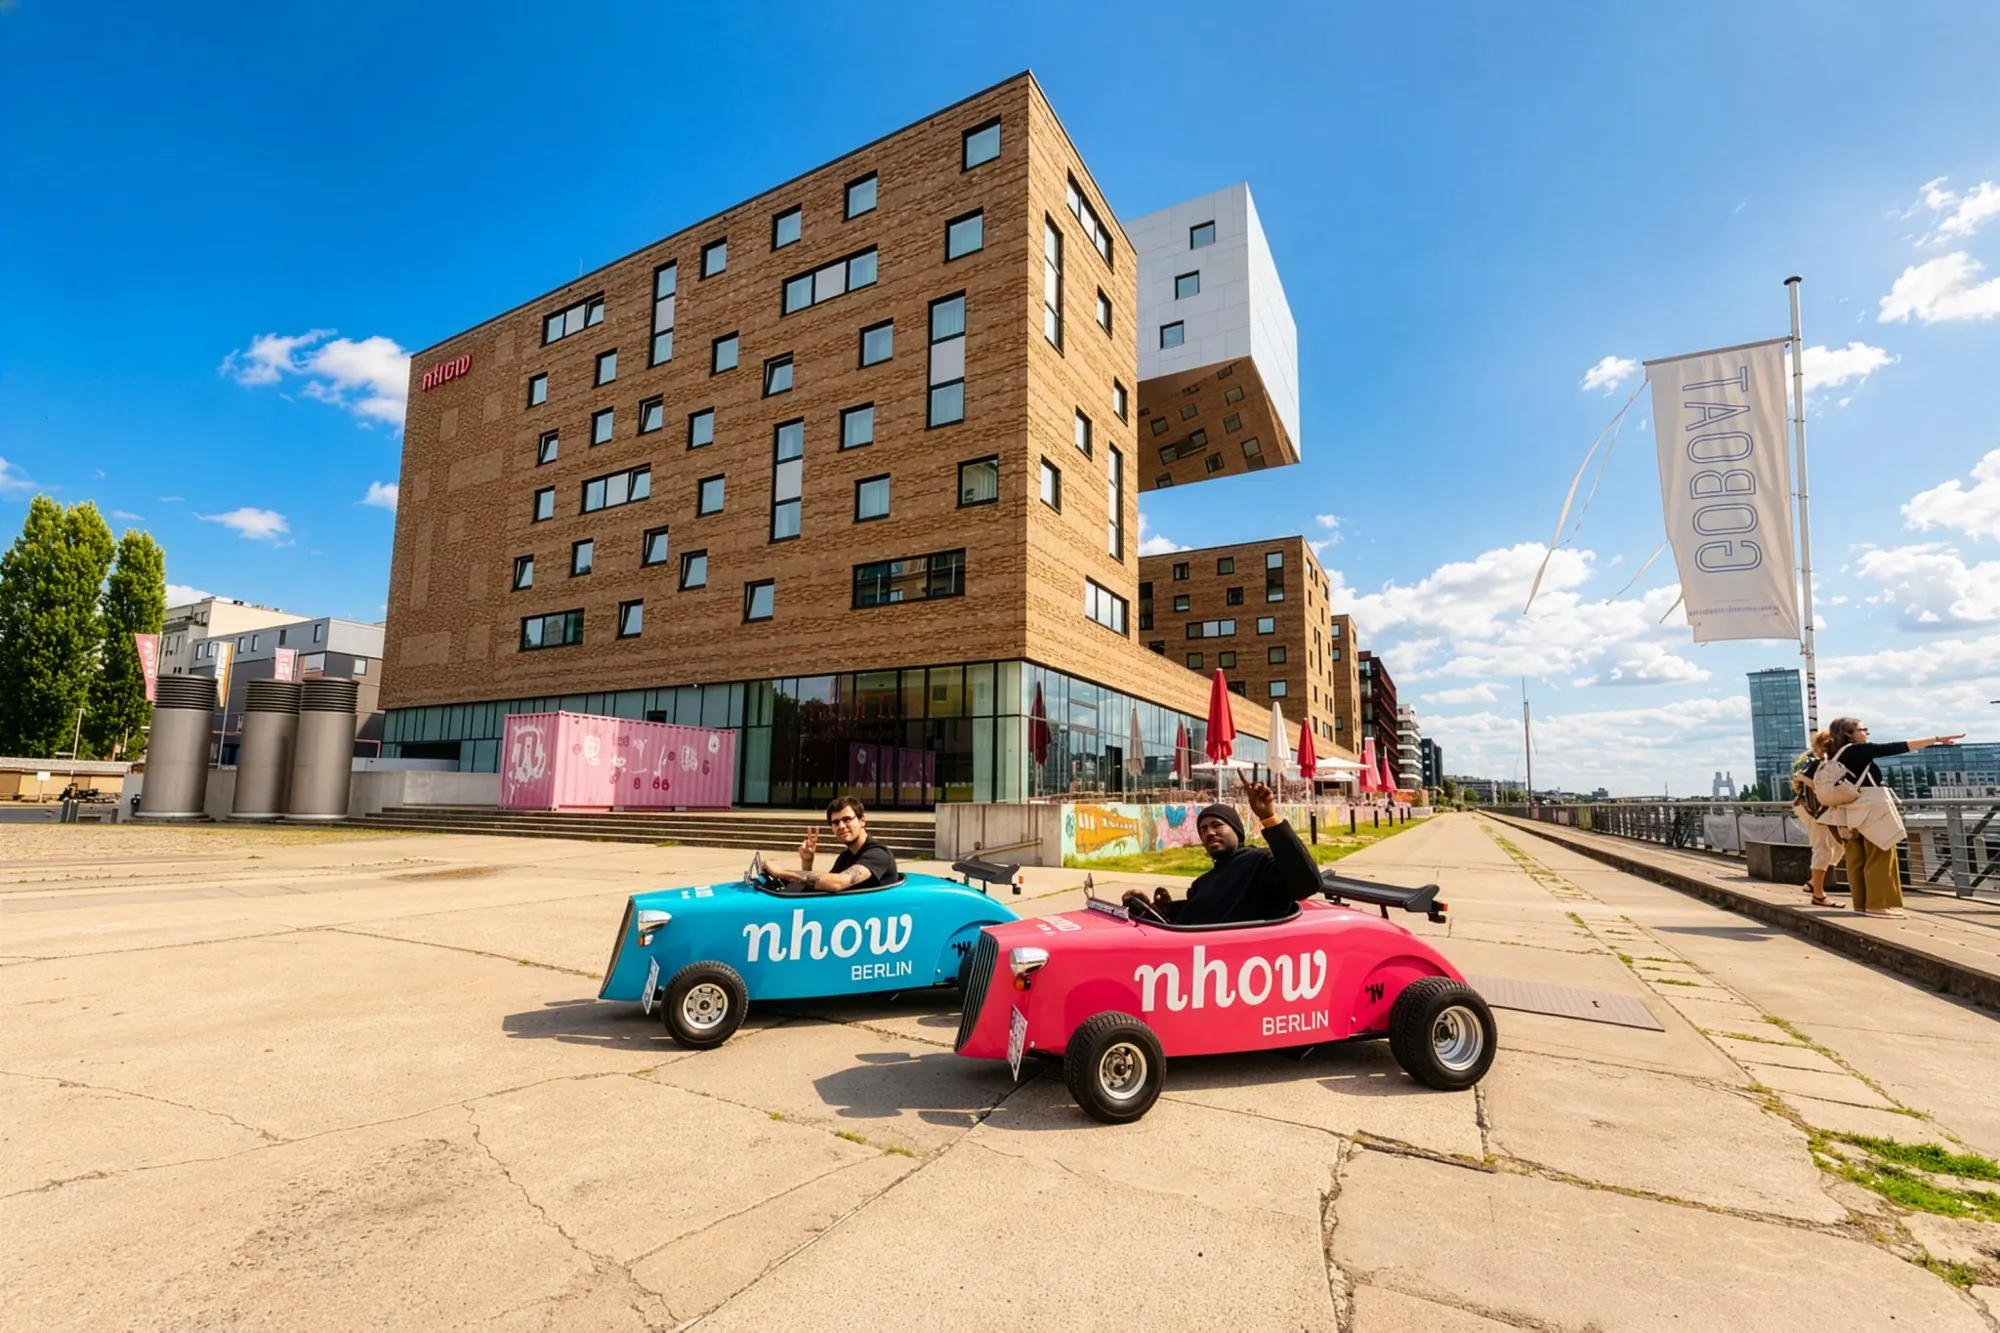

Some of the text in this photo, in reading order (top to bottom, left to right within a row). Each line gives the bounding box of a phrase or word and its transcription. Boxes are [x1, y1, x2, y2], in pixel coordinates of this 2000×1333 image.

[742, 909, 913, 963] nhow
[851, 960, 913, 981] BERLIN
[1134, 945, 1328, 1014] nhow
[1261, 1010, 1330, 1036] BERLIN
